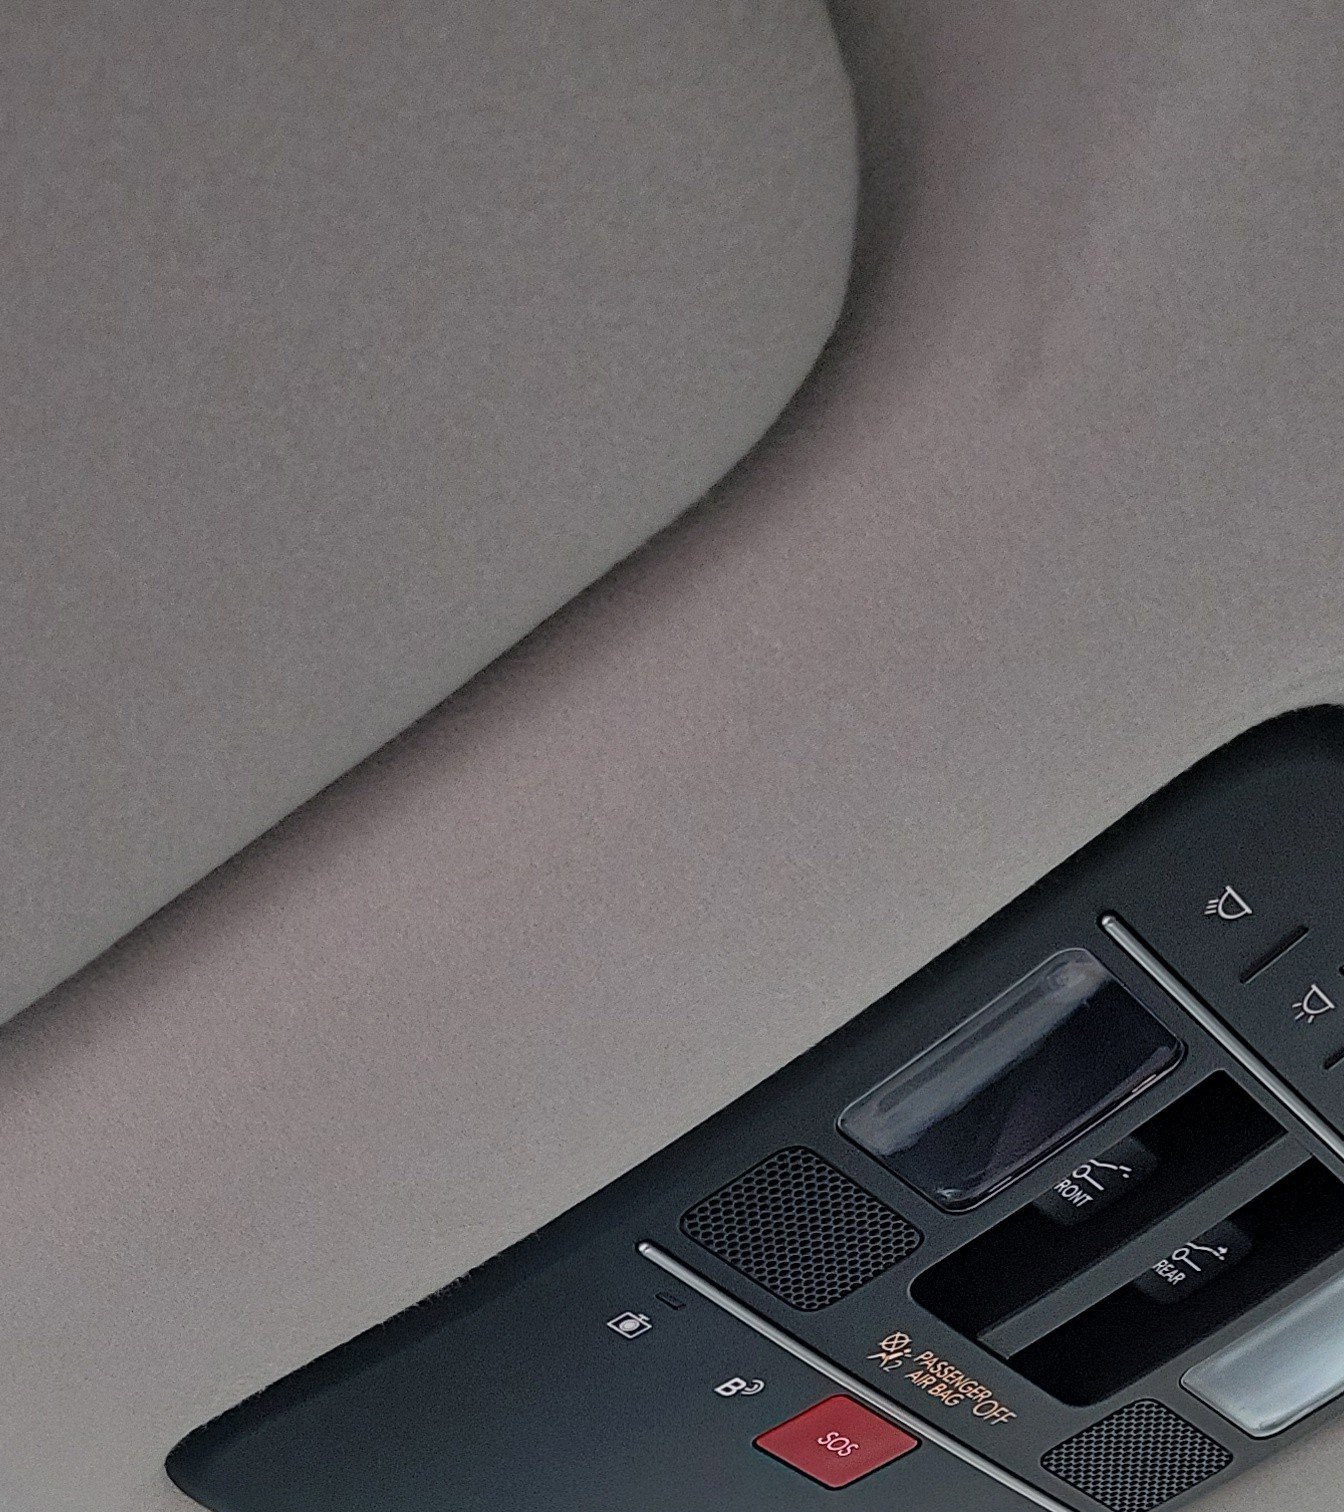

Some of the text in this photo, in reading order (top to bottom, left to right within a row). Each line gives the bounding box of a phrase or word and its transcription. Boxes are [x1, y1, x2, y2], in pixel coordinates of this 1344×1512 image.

[1053, 1179, 1093, 1207] RONT
[1152, 1259, 1187, 1286] REAR
[905, 1370, 965, 1406] AIR BAG
[913, 1351, 992, 1403] PASSENGER
[972, 1400, 1017, 1426] OFF
[817, 1431, 859, 1457] SOS
